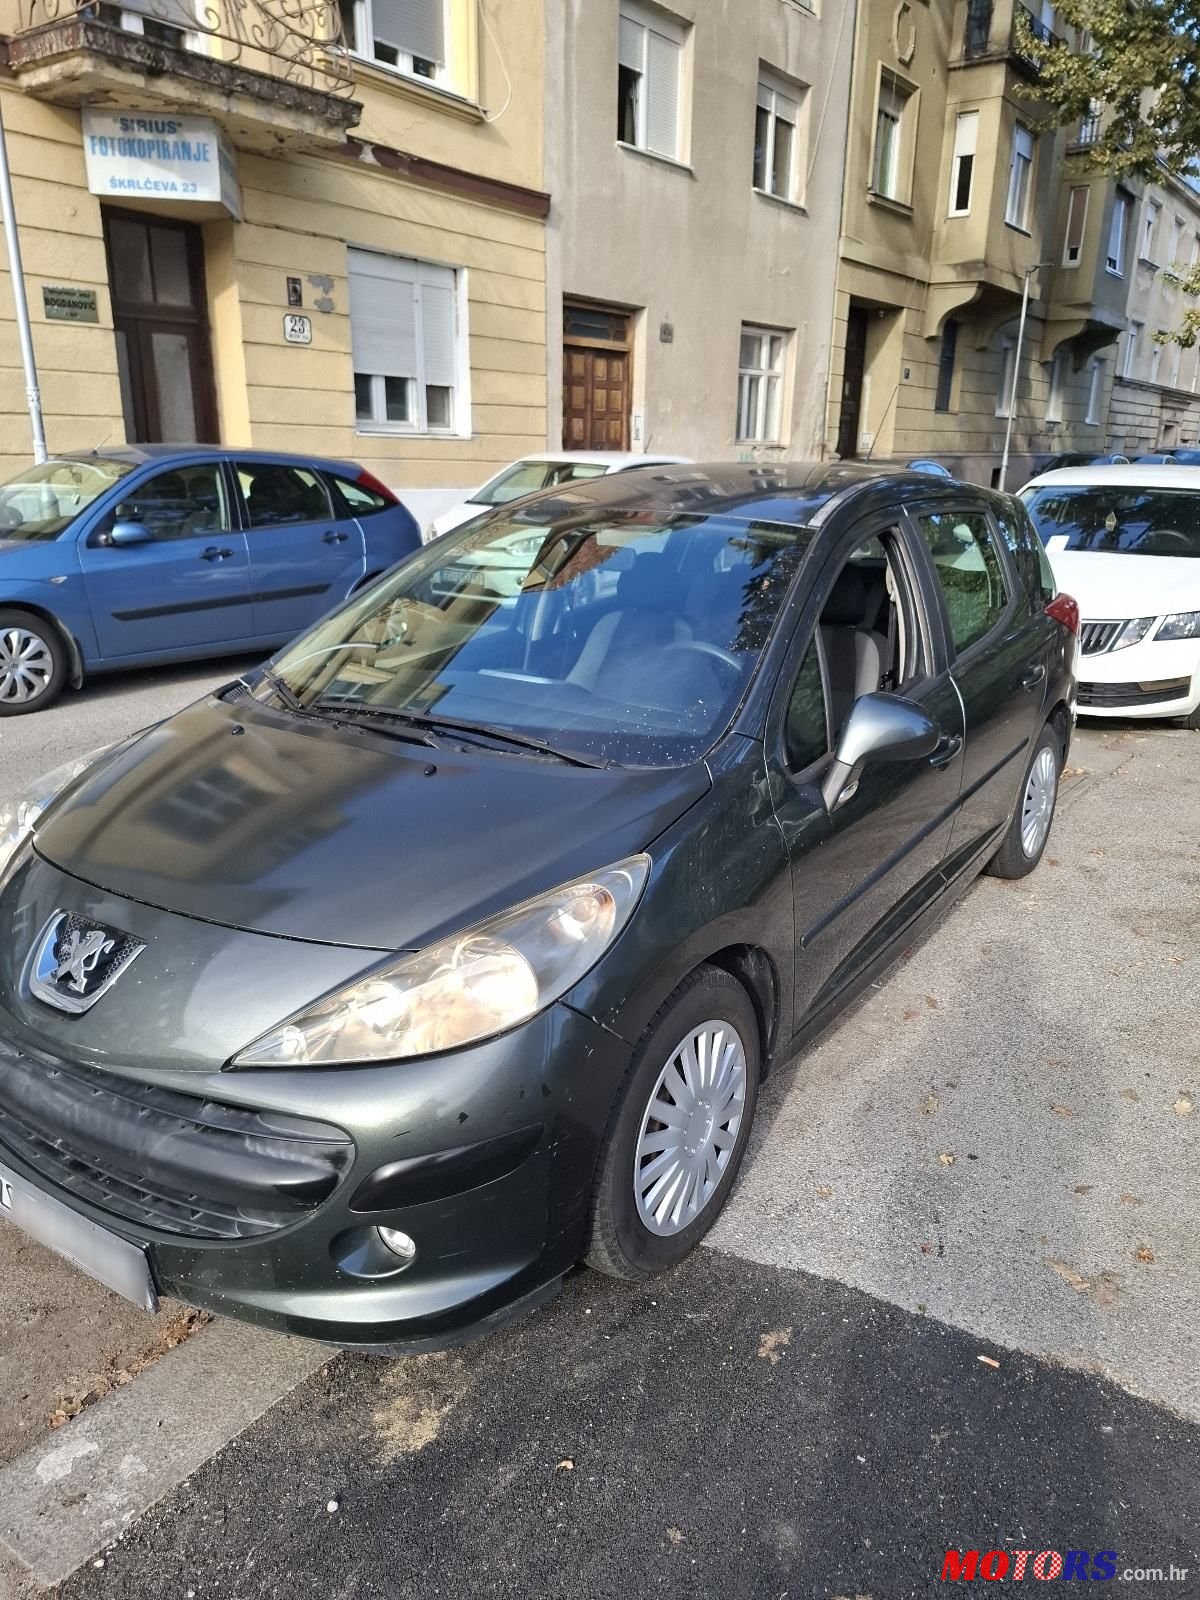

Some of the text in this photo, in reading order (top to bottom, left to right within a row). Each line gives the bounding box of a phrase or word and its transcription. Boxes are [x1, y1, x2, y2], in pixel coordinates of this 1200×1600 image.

[89, 135, 210, 162] FOTOKOPIRANJE
[109, 176, 198, 193] ŠKRLČEVA 23
[290, 316, 305, 334] 23
